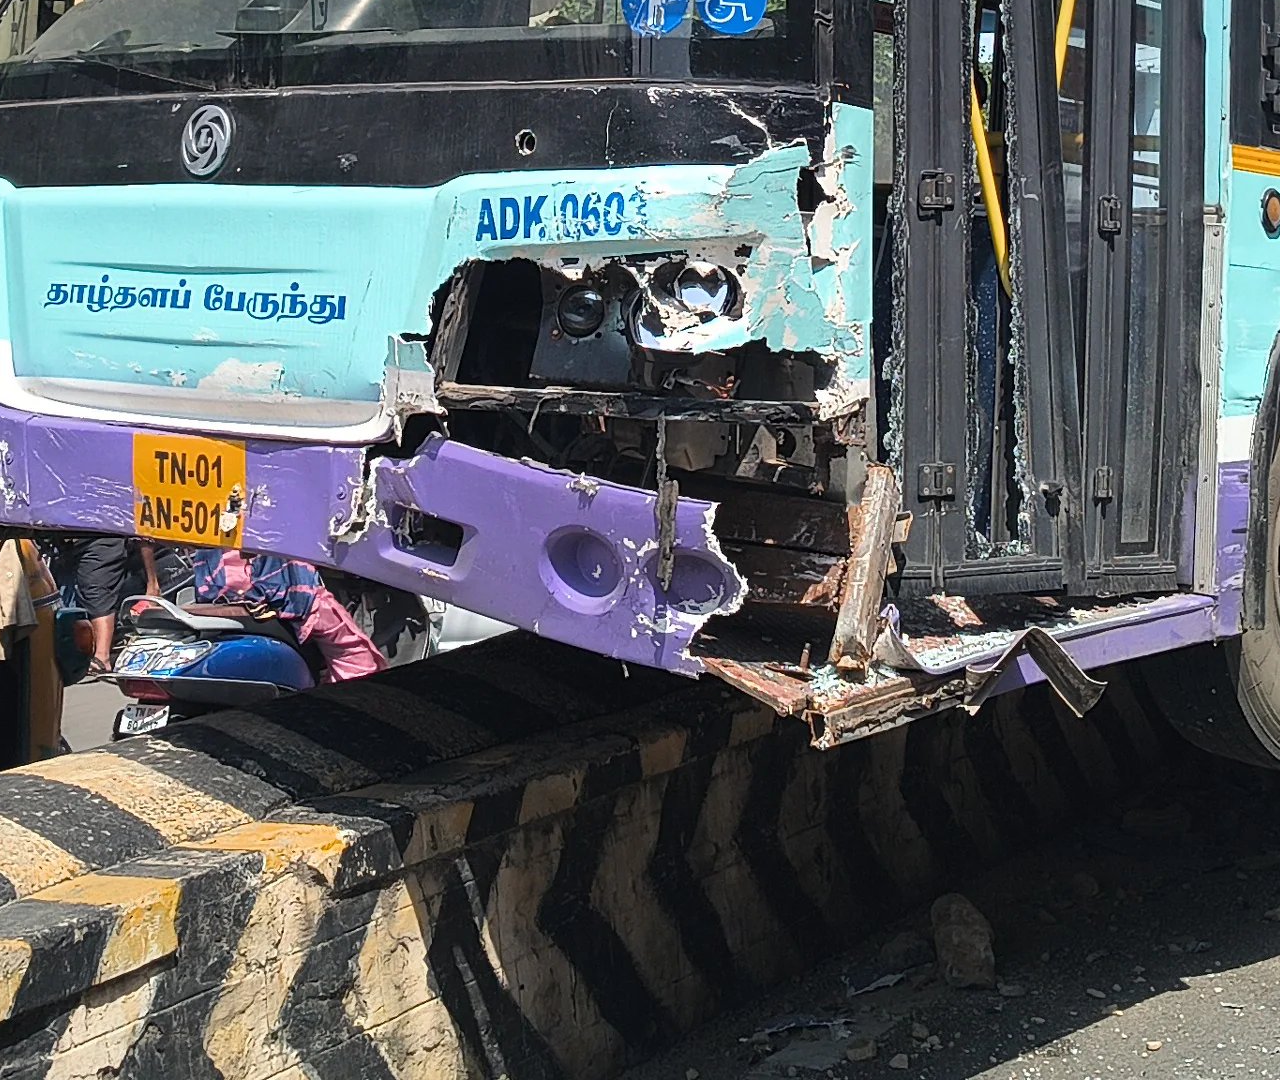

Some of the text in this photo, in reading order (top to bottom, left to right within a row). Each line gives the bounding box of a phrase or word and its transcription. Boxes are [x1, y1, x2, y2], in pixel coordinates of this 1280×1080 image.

[44, 274, 347, 325] தாழ்தளப் பேருந்து
[154, 450, 223, 488] TN-01
[140, 495, 232, 538] AN-501
